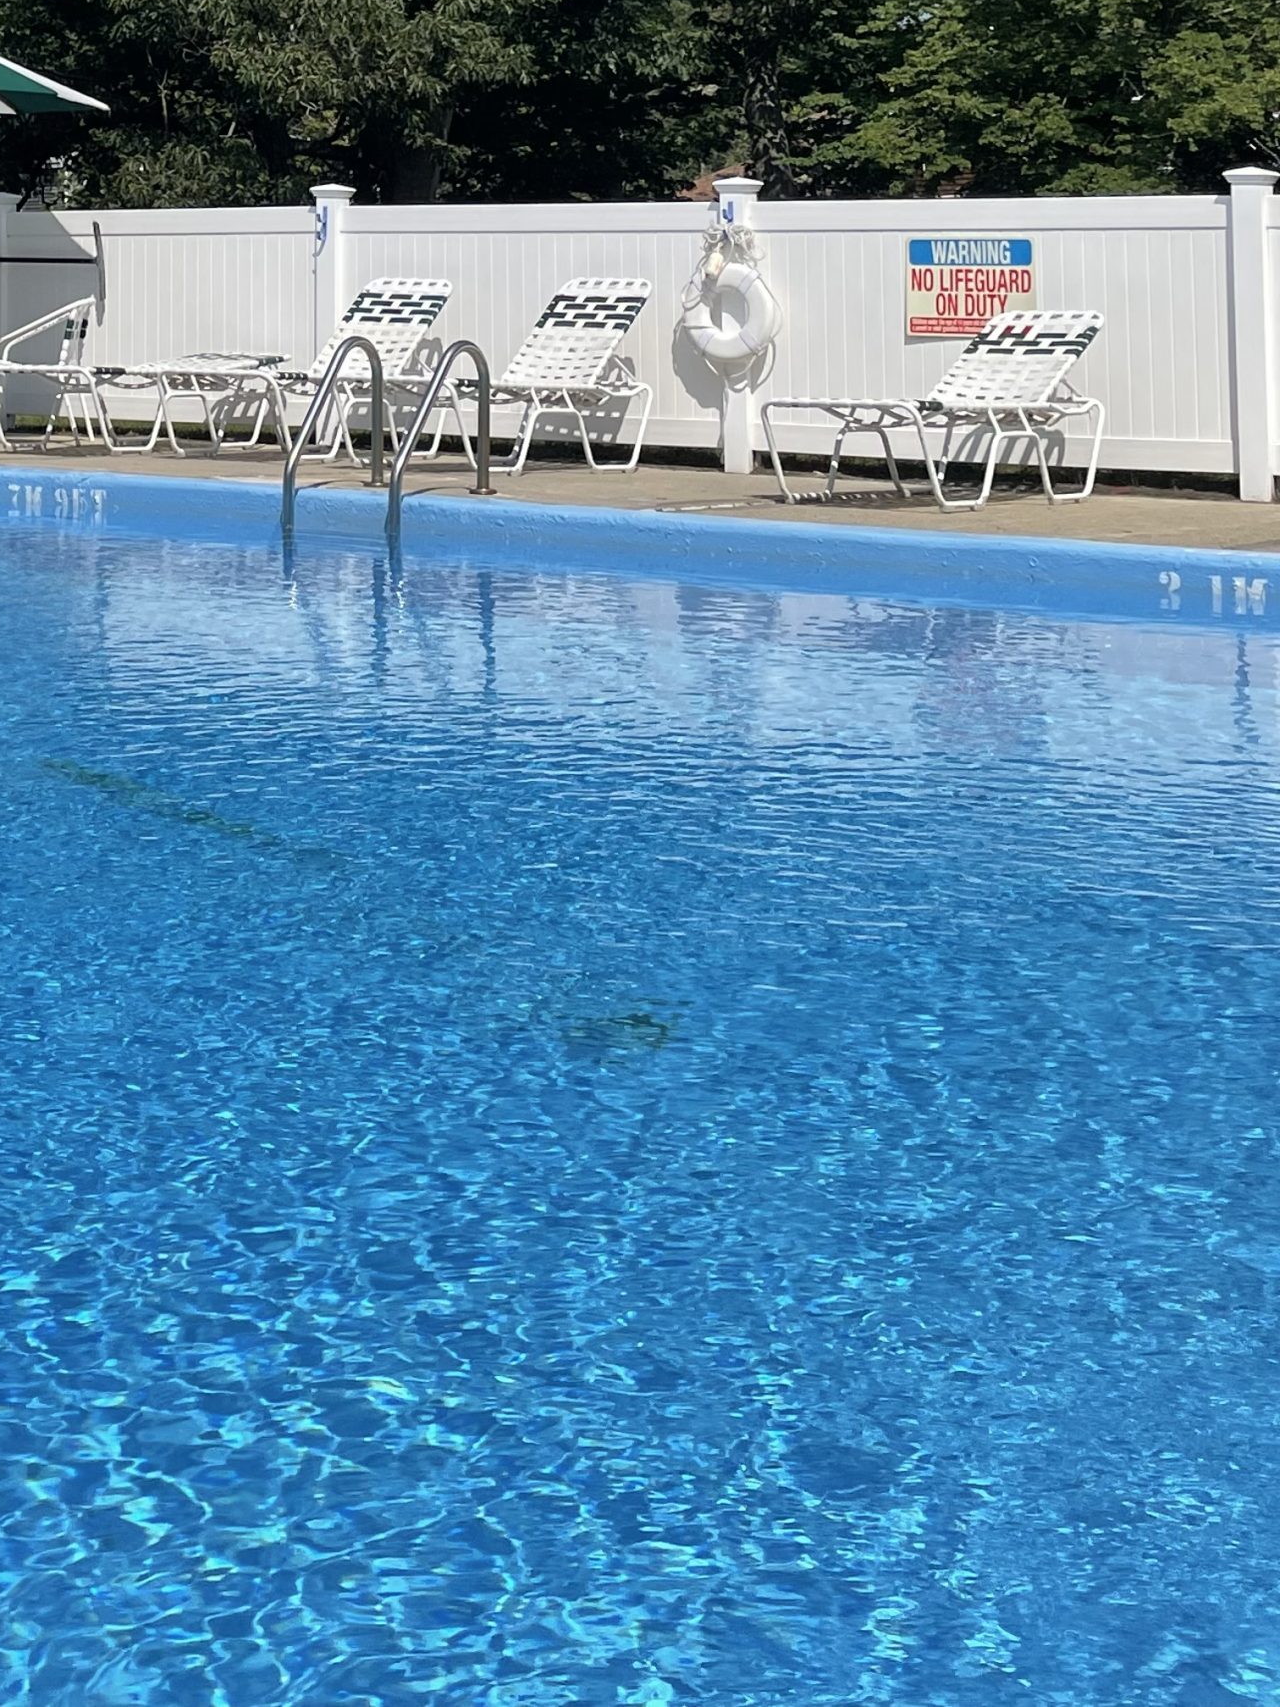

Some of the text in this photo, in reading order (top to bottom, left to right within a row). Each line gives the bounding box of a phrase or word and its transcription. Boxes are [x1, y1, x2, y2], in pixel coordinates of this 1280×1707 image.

[931, 240, 1011, 264] WARNING
[911, 268, 1031, 293] NO LIFEGUARD
[936, 293, 1008, 316] ON DUTY
